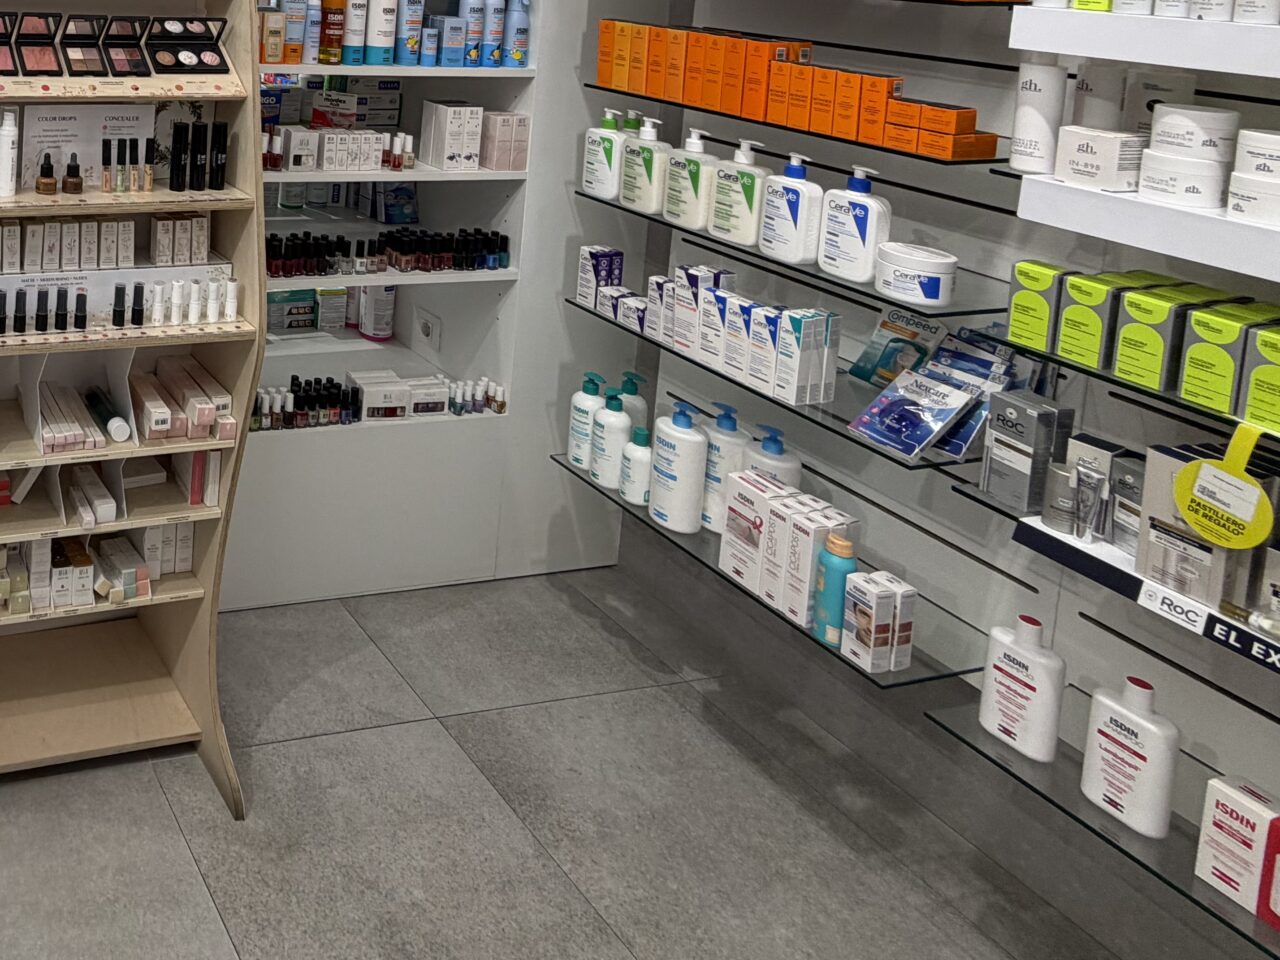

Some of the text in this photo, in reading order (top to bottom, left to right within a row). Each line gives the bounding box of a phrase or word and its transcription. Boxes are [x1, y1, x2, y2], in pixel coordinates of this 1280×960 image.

[1020, 78, 1043, 93] gh.
[587, 136, 612, 149] CeraVe
[1076, 141, 1098, 156] gh.
[624, 144, 651, 159] CeraVe
[669, 156, 697, 173] CeraVe
[717, 169, 753, 186] CeraVe
[766, 185, 798, 202] CeraVe
[828, 199, 866, 218] CeraVe
[892, 269, 929, 284] CeraVe
[888, 309, 941, 335] Compeed
[910, 378, 950, 401] Nexcare
[573, 404, 590, 417] ISDIN
[996, 413, 1025, 434] RoC
[656, 434, 677, 452] ISDIN
[737, 491, 755, 507] ISDIN
[769, 508, 787, 523] ISDIN
[1187, 504, 1200, 516] DE
[1190, 497, 1246, 532] PASTILLERO
[792, 522, 810, 538] ISDIN
[1160, 596, 1200, 623] RoC
[1213, 622, 1242, 649] EL
[1003, 651, 1029, 673] ISDIN
[1109, 715, 1139, 740] ISDIN
[1215, 798, 1257, 833] ISDIN
